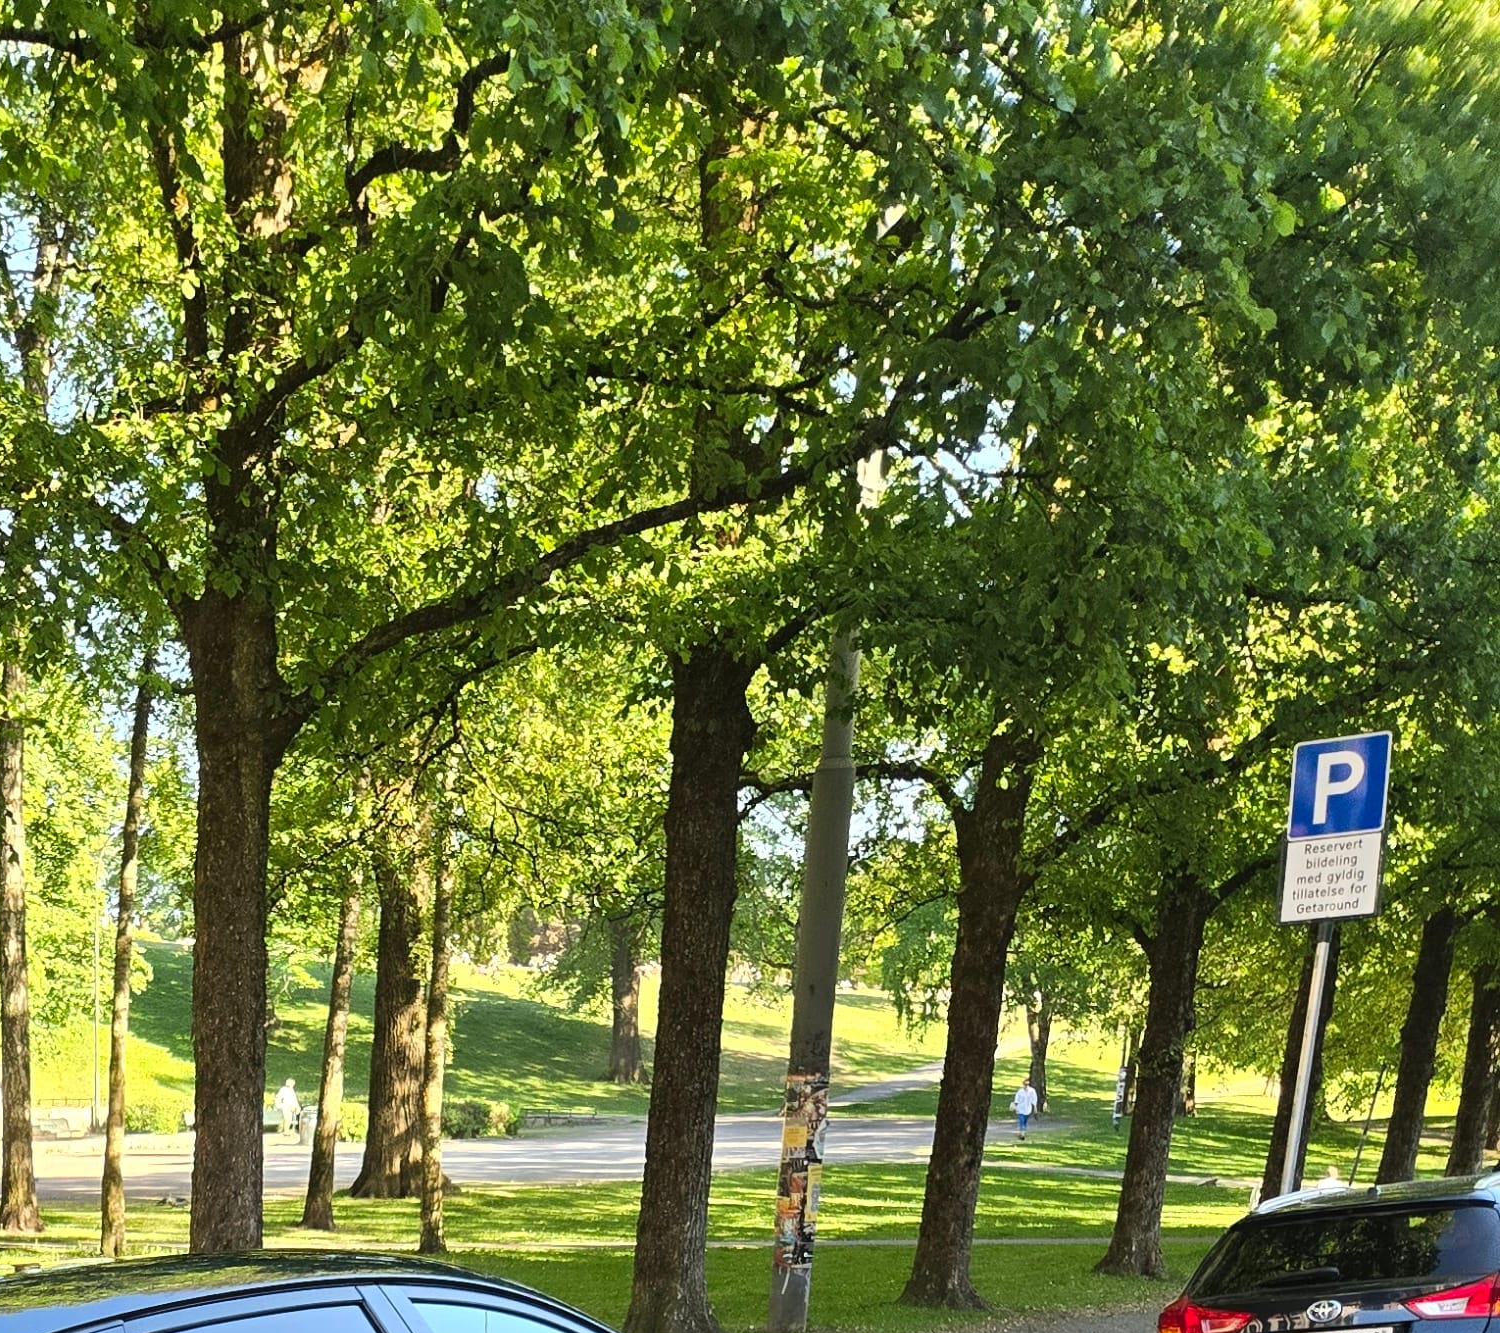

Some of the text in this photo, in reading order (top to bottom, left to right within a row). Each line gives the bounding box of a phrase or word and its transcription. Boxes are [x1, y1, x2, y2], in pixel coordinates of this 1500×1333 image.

[1313, 750, 1366, 825] P
[1304, 839, 1363, 855] Reservert
[1306, 855, 1358, 869] bildeling
[1296, 868, 1364, 885] med gyldig
[1292, 883, 1368, 901] tillatelse for
[1296, 898, 1359, 914] Getaround
